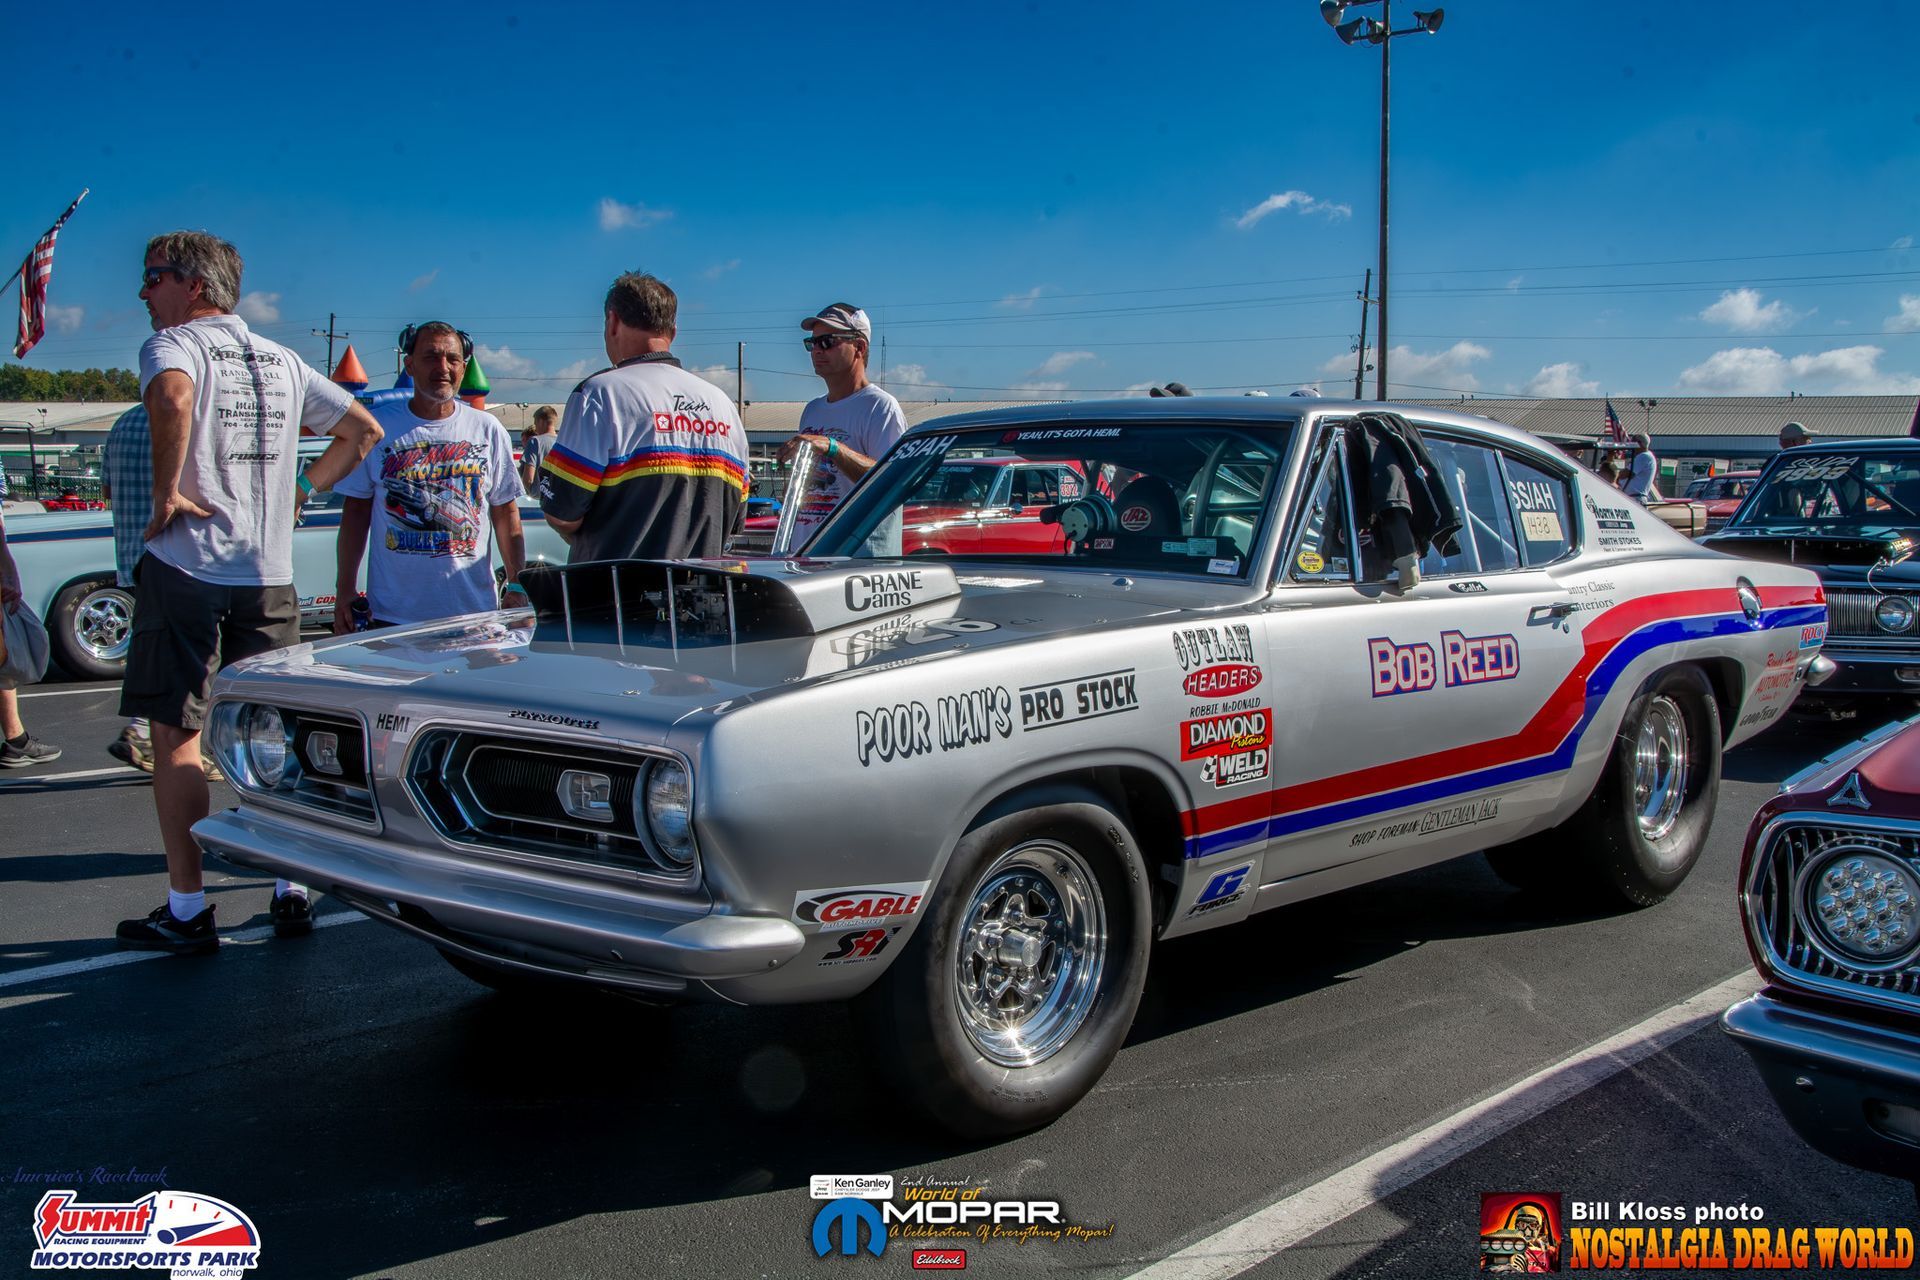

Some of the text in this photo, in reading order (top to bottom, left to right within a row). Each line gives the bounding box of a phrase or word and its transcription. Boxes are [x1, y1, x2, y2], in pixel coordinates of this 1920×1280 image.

[673, 394, 711, 412] Team
[217, 407, 287, 421] TRANSMISSION
[1042, 430, 1062, 439] IT'S
[1062, 429, 1085, 438] GOT
[1083, 429, 1093, 438] A
[888, 435, 958, 462] SS/AH
[431, 457, 482, 479] STOCK
[1509, 480, 1557, 510] SS/AH
[1593, 504, 1632, 520] NORTH POINT
[1526, 515, 1552, 536] 1438
[1598, 536, 1642, 546] SMITH STOKES
[1587, 580, 1616, 593] Classic
[1172, 623, 1255, 671] OUTLAW
[1440, 629, 1521, 688] REED
[1186, 668, 1259, 694] HEADERS
[1189, 697, 1261, 718] ROBBIE McDONALD
[376, 712, 410, 733] HEMI
[507, 709, 601, 730] PLYMOUTH
[856, 674, 1138, 767] POOR MAN'S PRO STOCK
[1190, 712, 1266, 747] DIAMOND
[1230, 734, 1265, 749] Pistons
[1219, 748, 1267, 777] WELD
[1226, 769, 1265, 784] RACING
[1349, 829, 1377, 848] SHOP
[820, 895, 923, 923] GABLE
